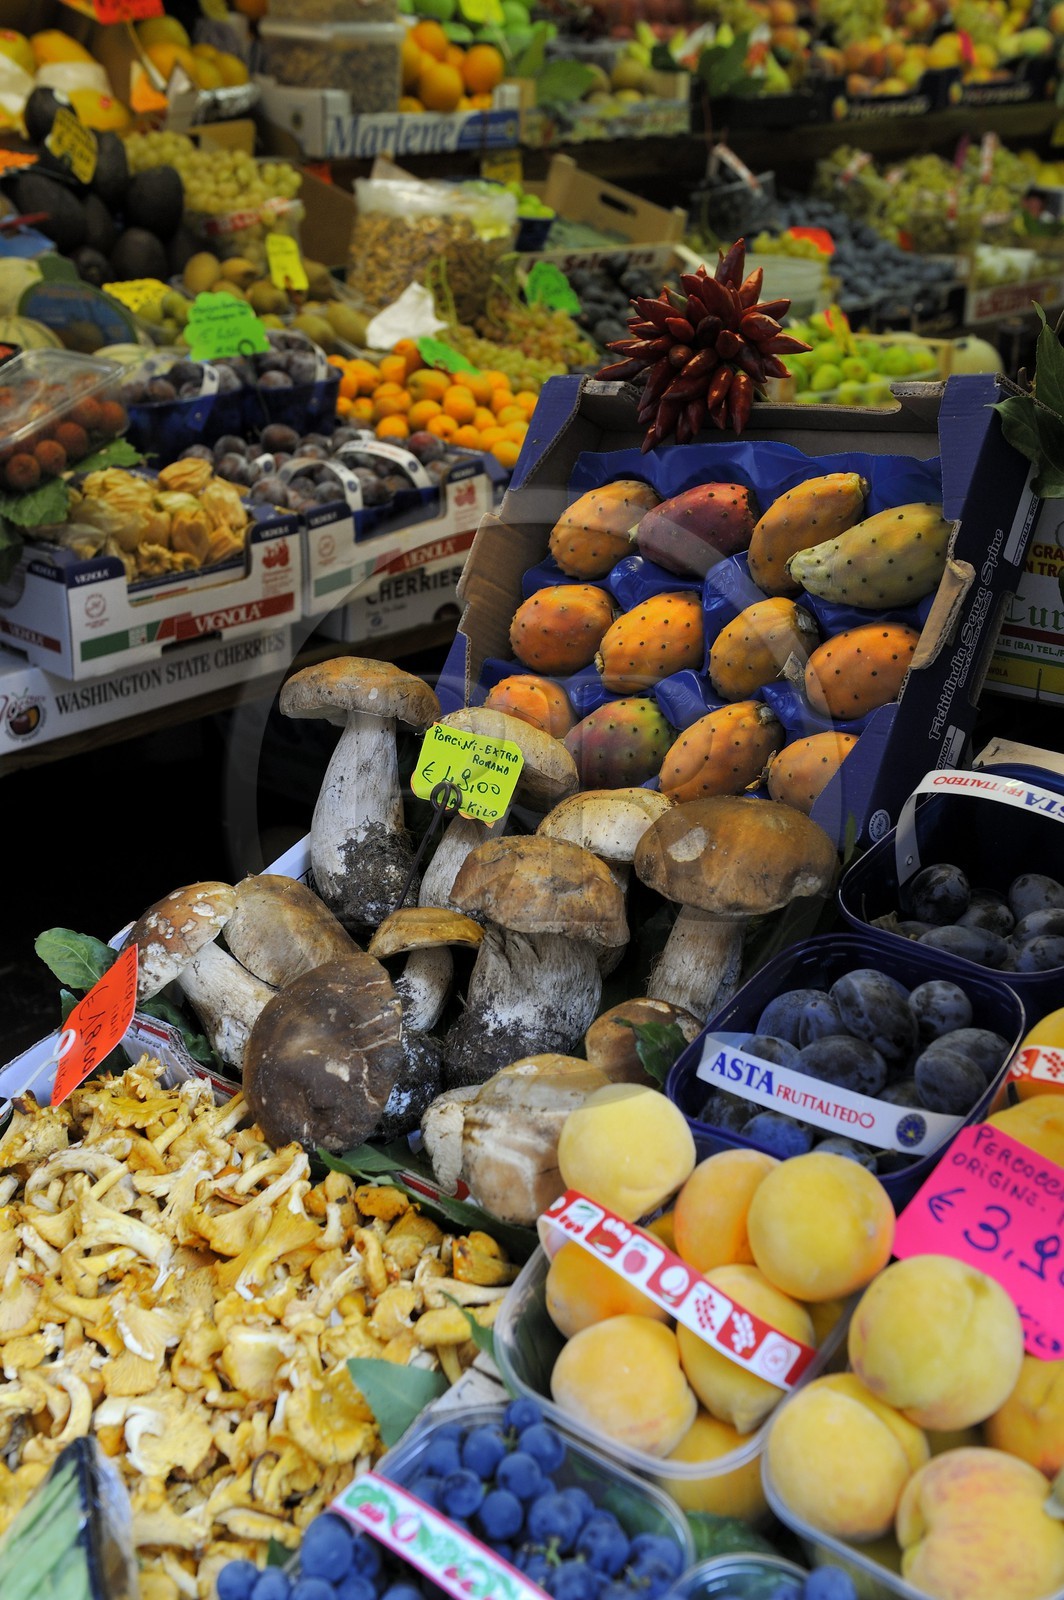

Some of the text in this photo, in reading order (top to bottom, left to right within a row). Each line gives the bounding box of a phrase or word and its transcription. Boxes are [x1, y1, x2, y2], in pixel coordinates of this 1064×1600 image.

[326, 114, 454, 158] Marlene
[1020, 522, 1031, 547] ITALIA
[195, 604, 261, 633] VIGNOLA
[929, 529, 1004, 740] Fichidindia Senza Spine
[1014, 640, 1034, 653] (BA)
[55, 667, 162, 715] WASHINGTON
[166, 652, 211, 685] STATE
[214, 631, 286, 670] CHERRIES
[422, 761, 436, 783] €
[79, 985, 109, 1021] €
[710, 1052, 775, 1096] ASTA
[776, 1084, 876, 1130] FRUTTALTEDO
[928, 1187, 966, 1223] €
